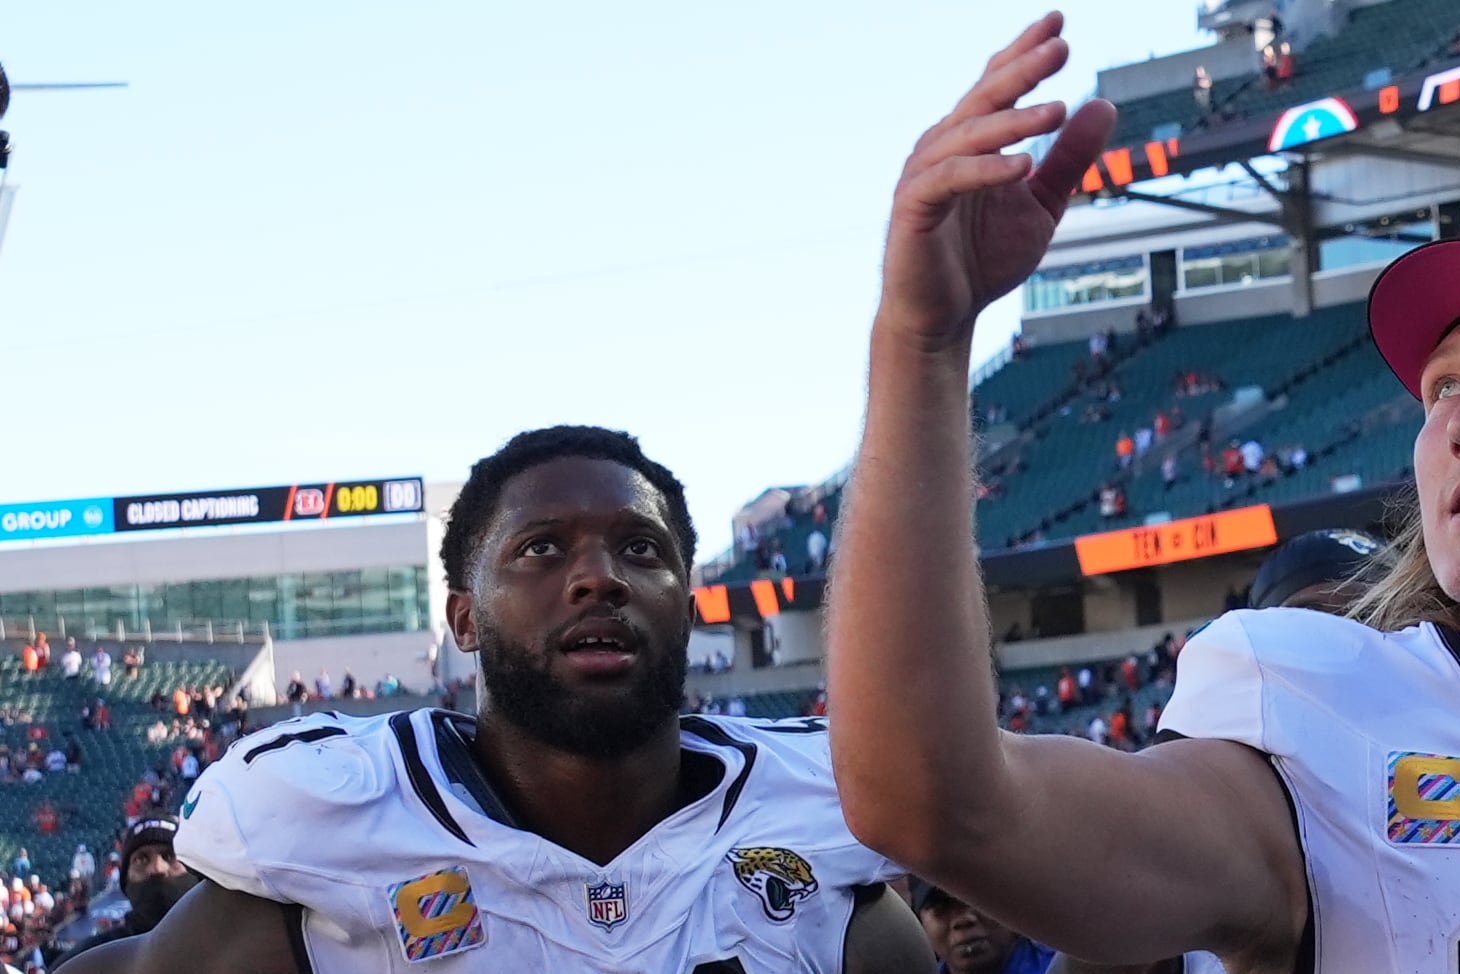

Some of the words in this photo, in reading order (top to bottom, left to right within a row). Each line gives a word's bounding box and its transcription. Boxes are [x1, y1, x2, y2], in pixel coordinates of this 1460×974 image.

[127, 500, 180, 525] CLOSED
[181, 494, 259, 522] CAPTIONING
[337, 485, 378, 512] 0:00
[2, 509, 72, 532] GROUP
[397, 873, 475, 938] C
[594, 901, 624, 922] NFL
